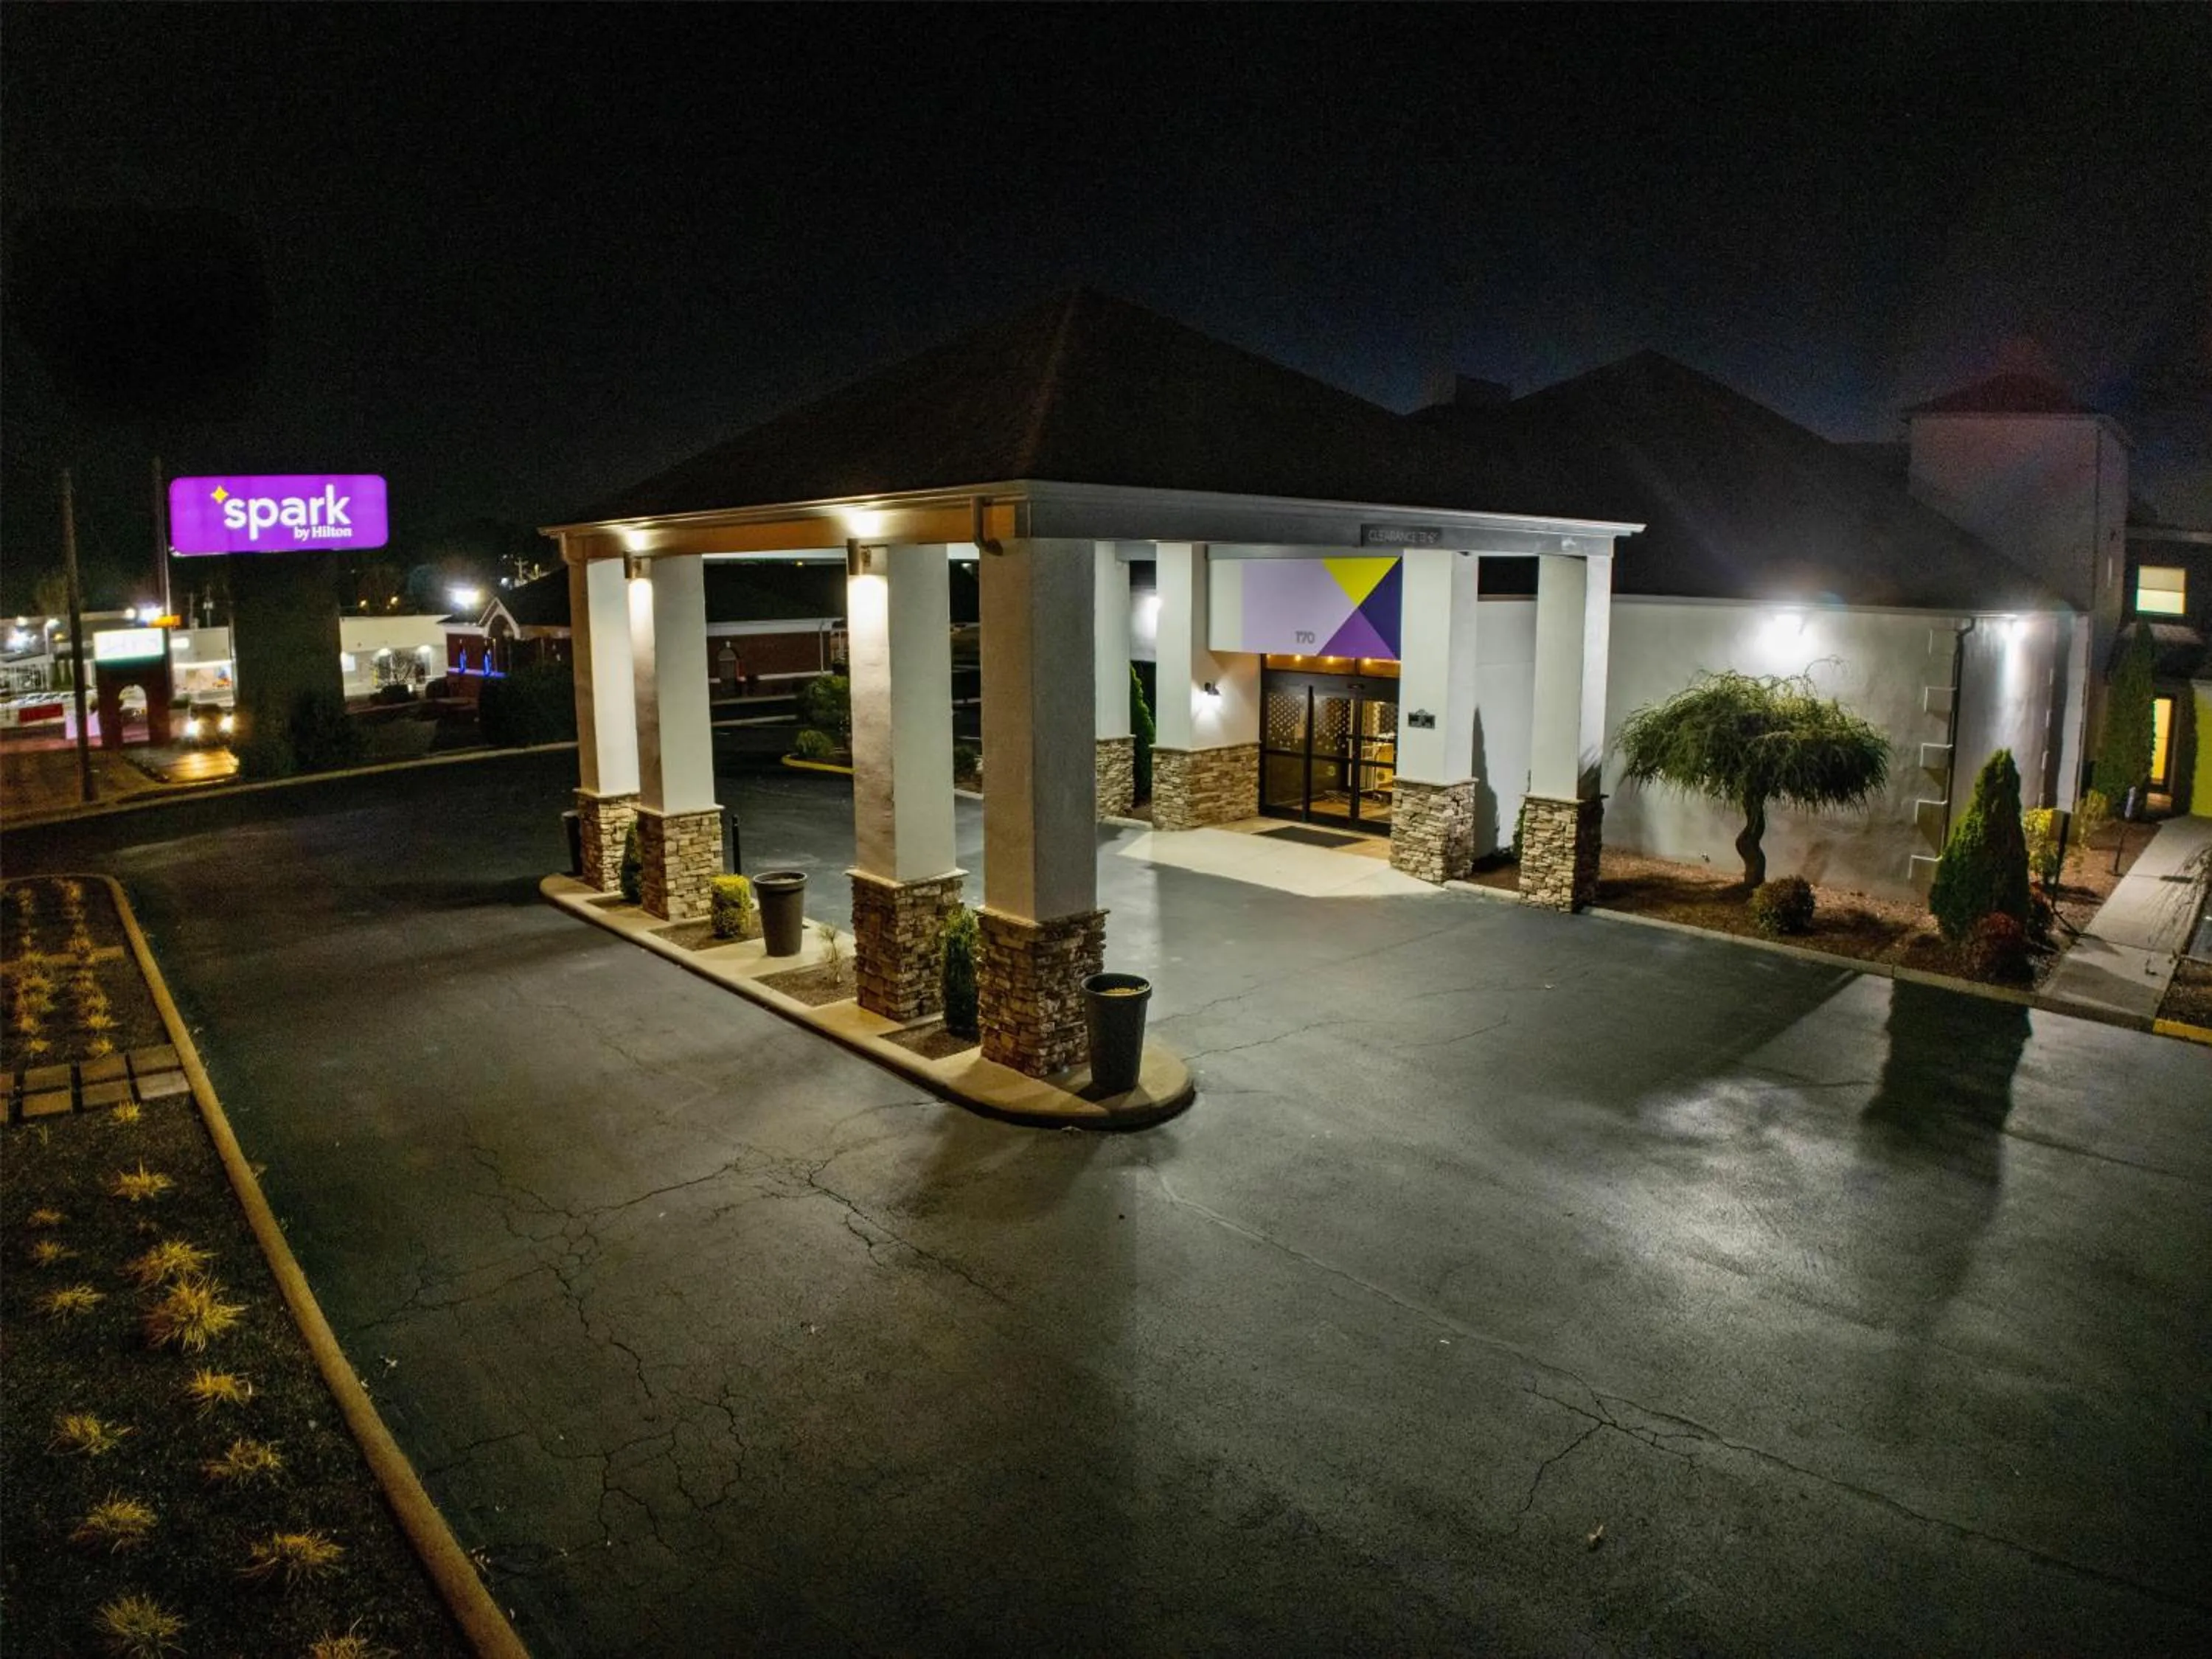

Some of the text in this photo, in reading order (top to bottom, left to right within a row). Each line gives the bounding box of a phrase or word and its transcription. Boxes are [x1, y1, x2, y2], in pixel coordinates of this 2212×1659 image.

[224, 484, 352, 540] spark
[293, 526, 352, 541] by Hilton
